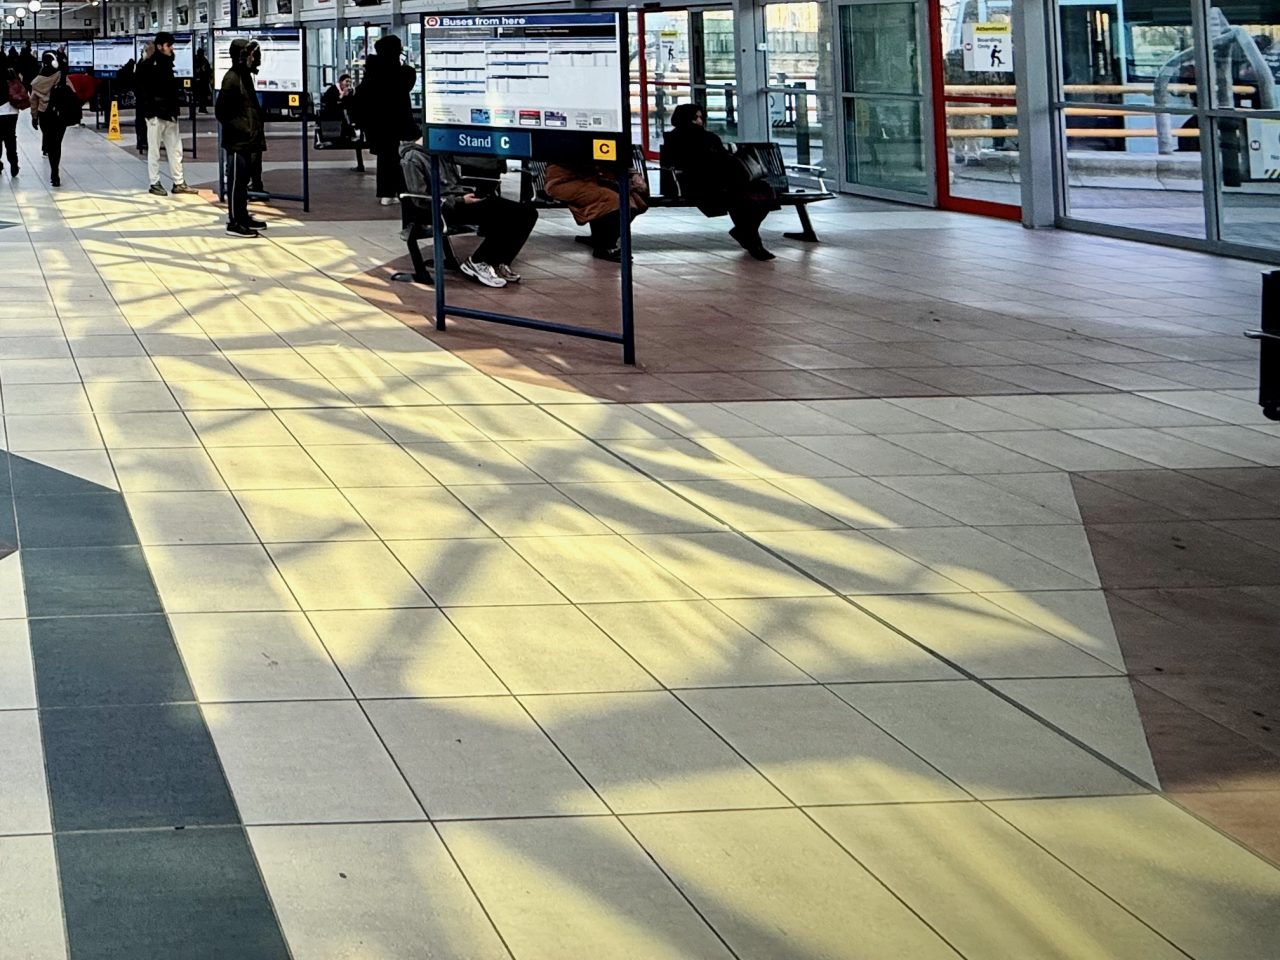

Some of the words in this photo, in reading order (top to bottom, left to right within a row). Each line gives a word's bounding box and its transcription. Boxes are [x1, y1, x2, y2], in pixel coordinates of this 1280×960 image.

[442, 18, 473, 26] Buses
[475, 17, 499, 25] from
[501, 16, 526, 25] here
[458, 133, 491, 148] Stand
[500, 136, 510, 149] C
[599, 143, 610, 154] C
